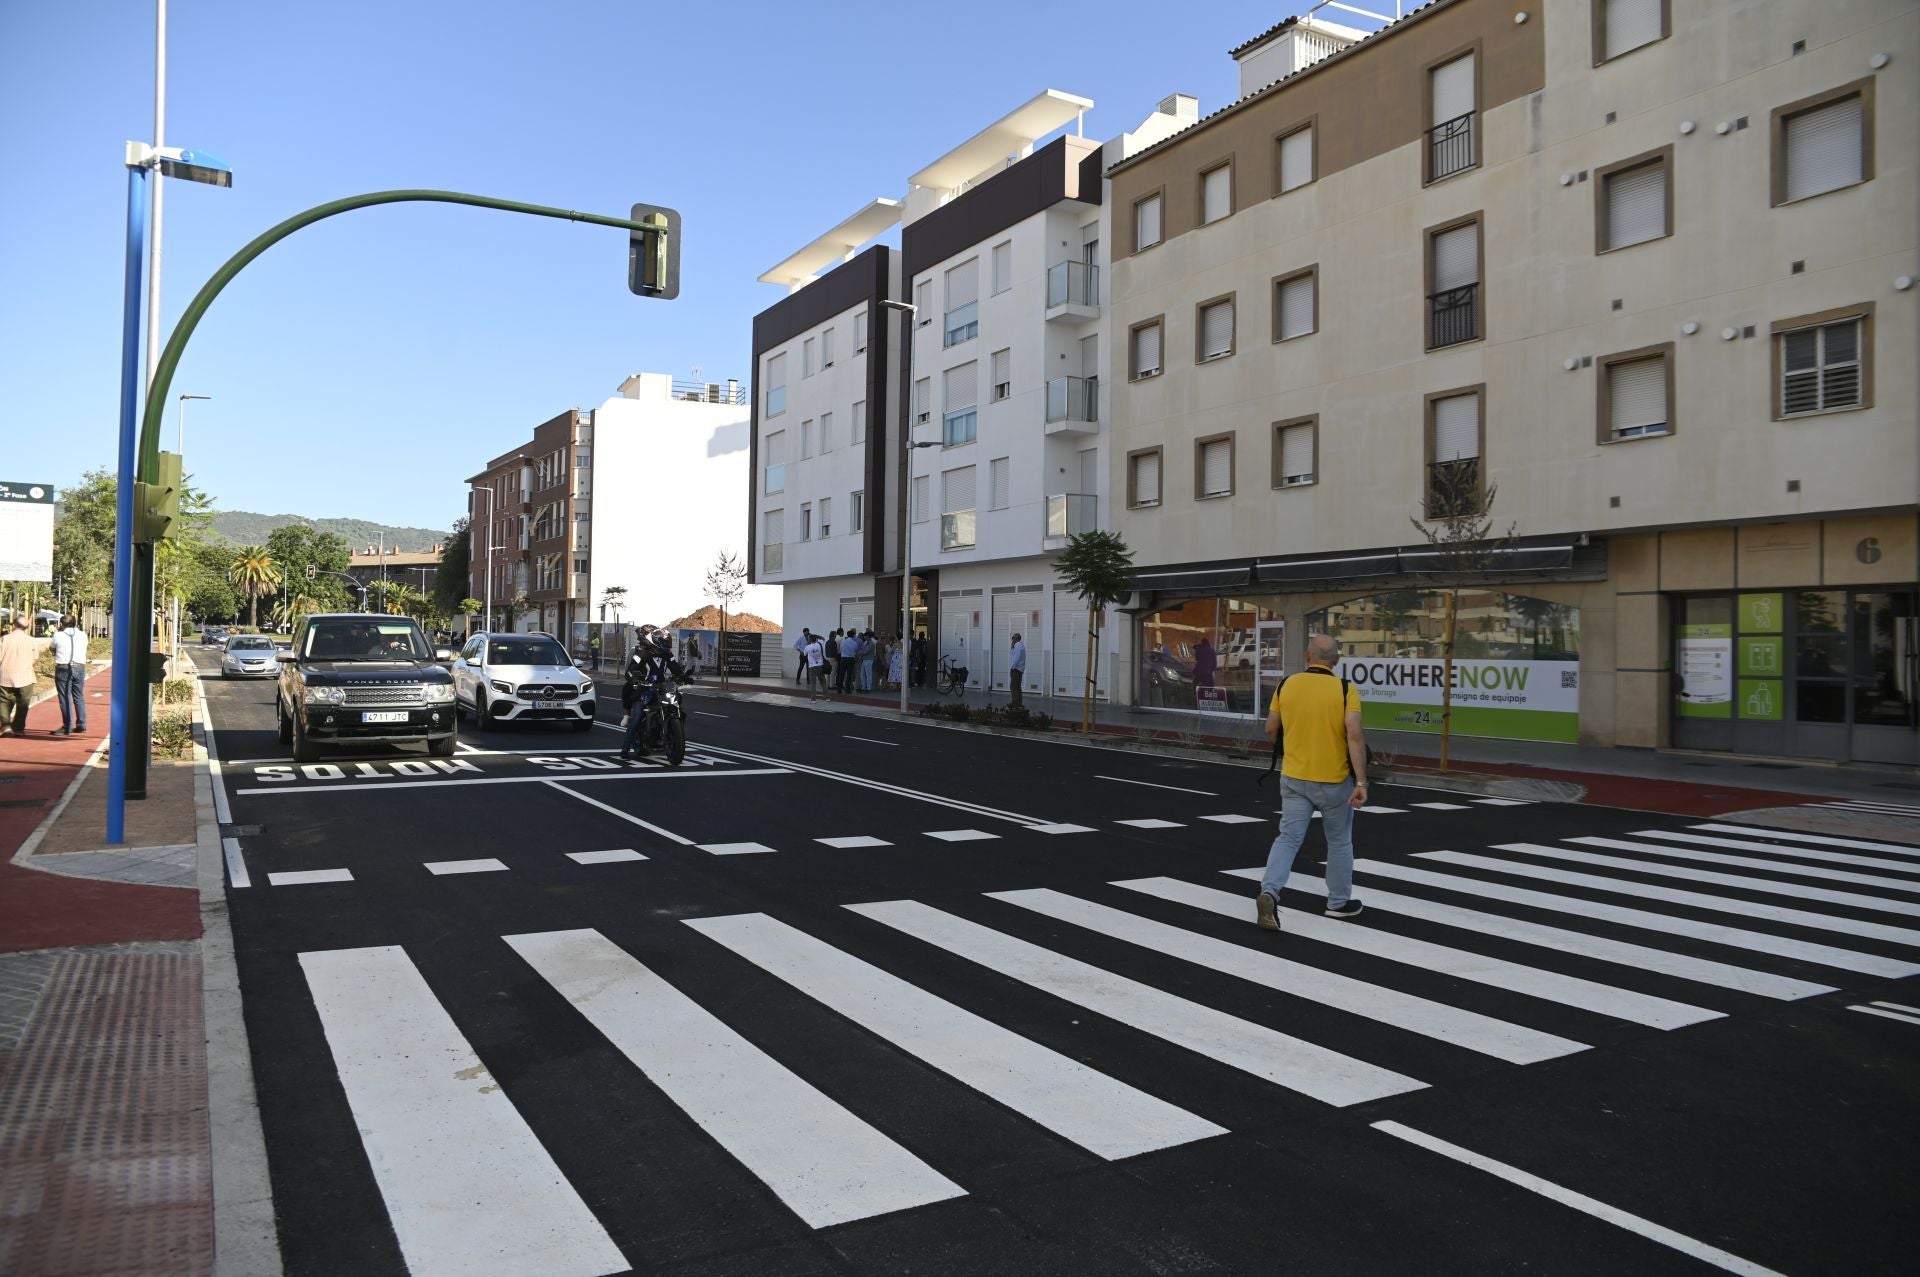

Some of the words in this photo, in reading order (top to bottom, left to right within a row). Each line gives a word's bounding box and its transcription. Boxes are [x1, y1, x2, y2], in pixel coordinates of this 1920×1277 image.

[1856, 537, 1882, 565] 6
[1371, 687, 1397, 698] Storage
[1479, 691, 1490, 701] de
[1491, 692, 1528, 704] equipaje
[368, 712, 388, 721] 4711
[391, 712, 407, 721] JTC
[1415, 711, 1430, 724] 24
[254, 759, 486, 782] MOTOS
